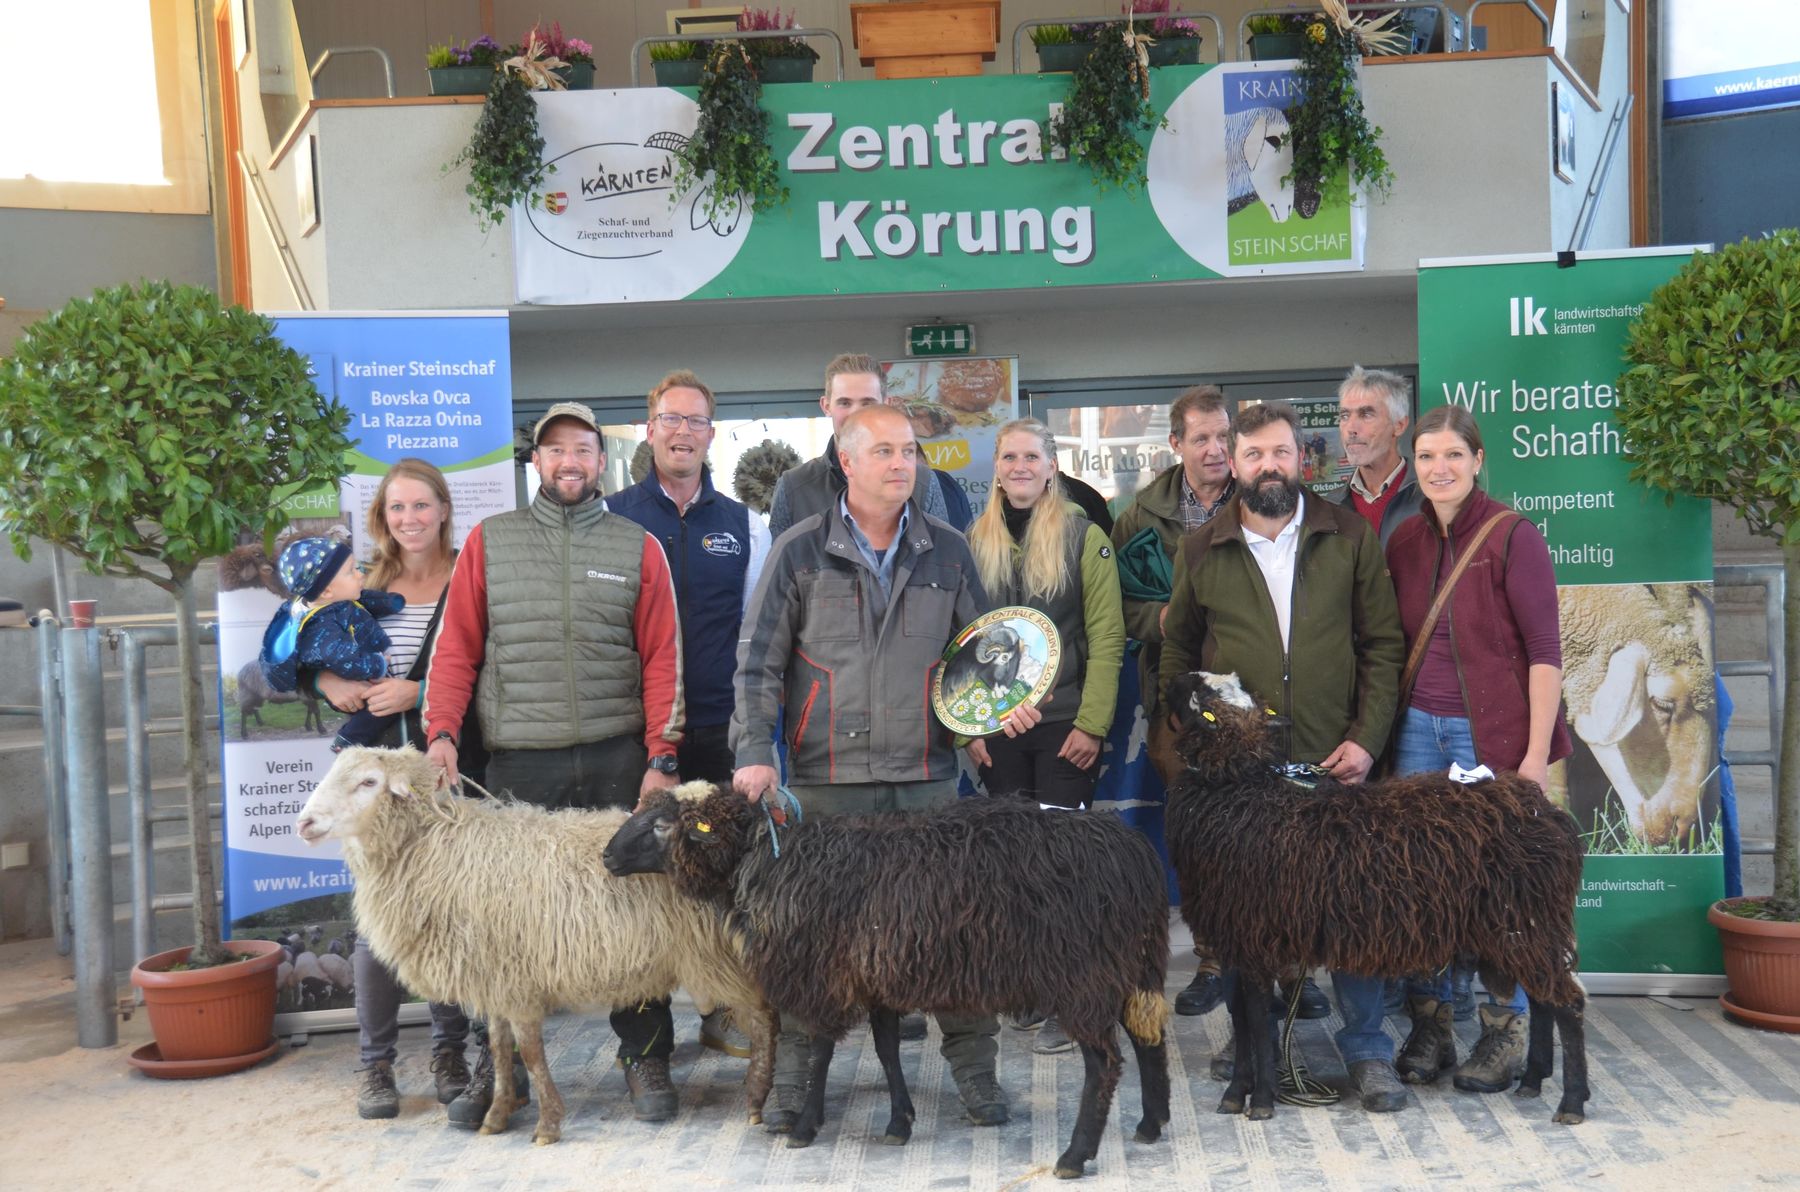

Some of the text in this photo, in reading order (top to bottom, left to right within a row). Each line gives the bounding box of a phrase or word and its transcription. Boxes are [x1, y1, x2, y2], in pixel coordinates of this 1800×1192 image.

[1239, 77, 1310, 100] KRAIN
[787, 102, 1066, 170] Zentral
[598, 217, 650, 227] Schaf- und
[576, 229, 674, 240] Ziegenzuchtverband
[817, 199, 1093, 264] Körung
[1554, 304, 1644, 321] landwirtschaftsk
[1554, 322, 1596, 335] kärnten
[343, 359, 496, 377] Krainer Steinschaf
[370, 389, 471, 406] Bovska Ovca
[1442, 380, 1501, 413] Wir
[360, 410, 482, 428] La Razza Ovina
[1310, 416, 1332, 427] der
[387, 433, 459, 450] Plezzana
[1512, 490, 1615, 514] kompetent
[265, 759, 313, 775] Verein
[239, 779, 321, 797] Krainer Ste
[244, 802, 306, 817] schafzü
[248, 823, 292, 840] Alpen
[1581, 878, 1665, 892] Landwirtschaft
[1575, 895, 1602, 908] Land
